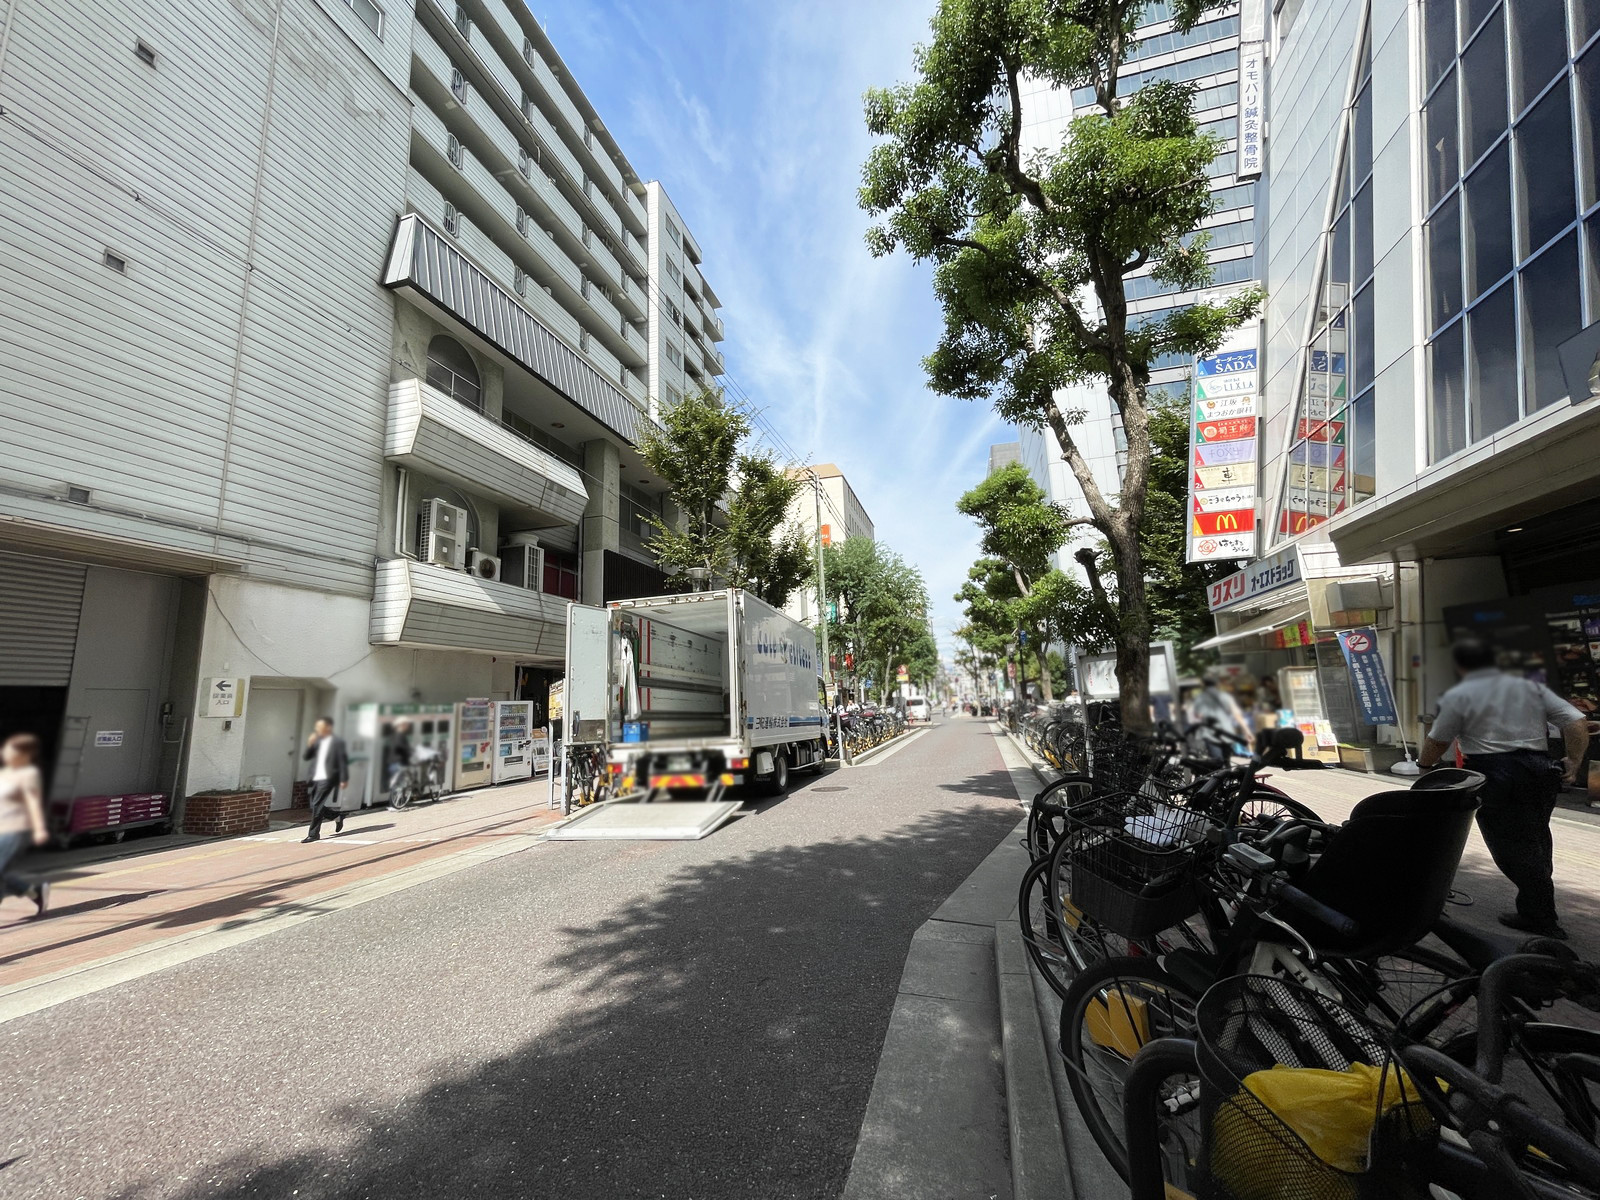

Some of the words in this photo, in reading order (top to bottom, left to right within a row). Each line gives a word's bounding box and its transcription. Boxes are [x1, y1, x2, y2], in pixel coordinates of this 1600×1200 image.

[1216, 360, 1255, 373] SADA
[1212, 572, 1245, 606] クスリ
